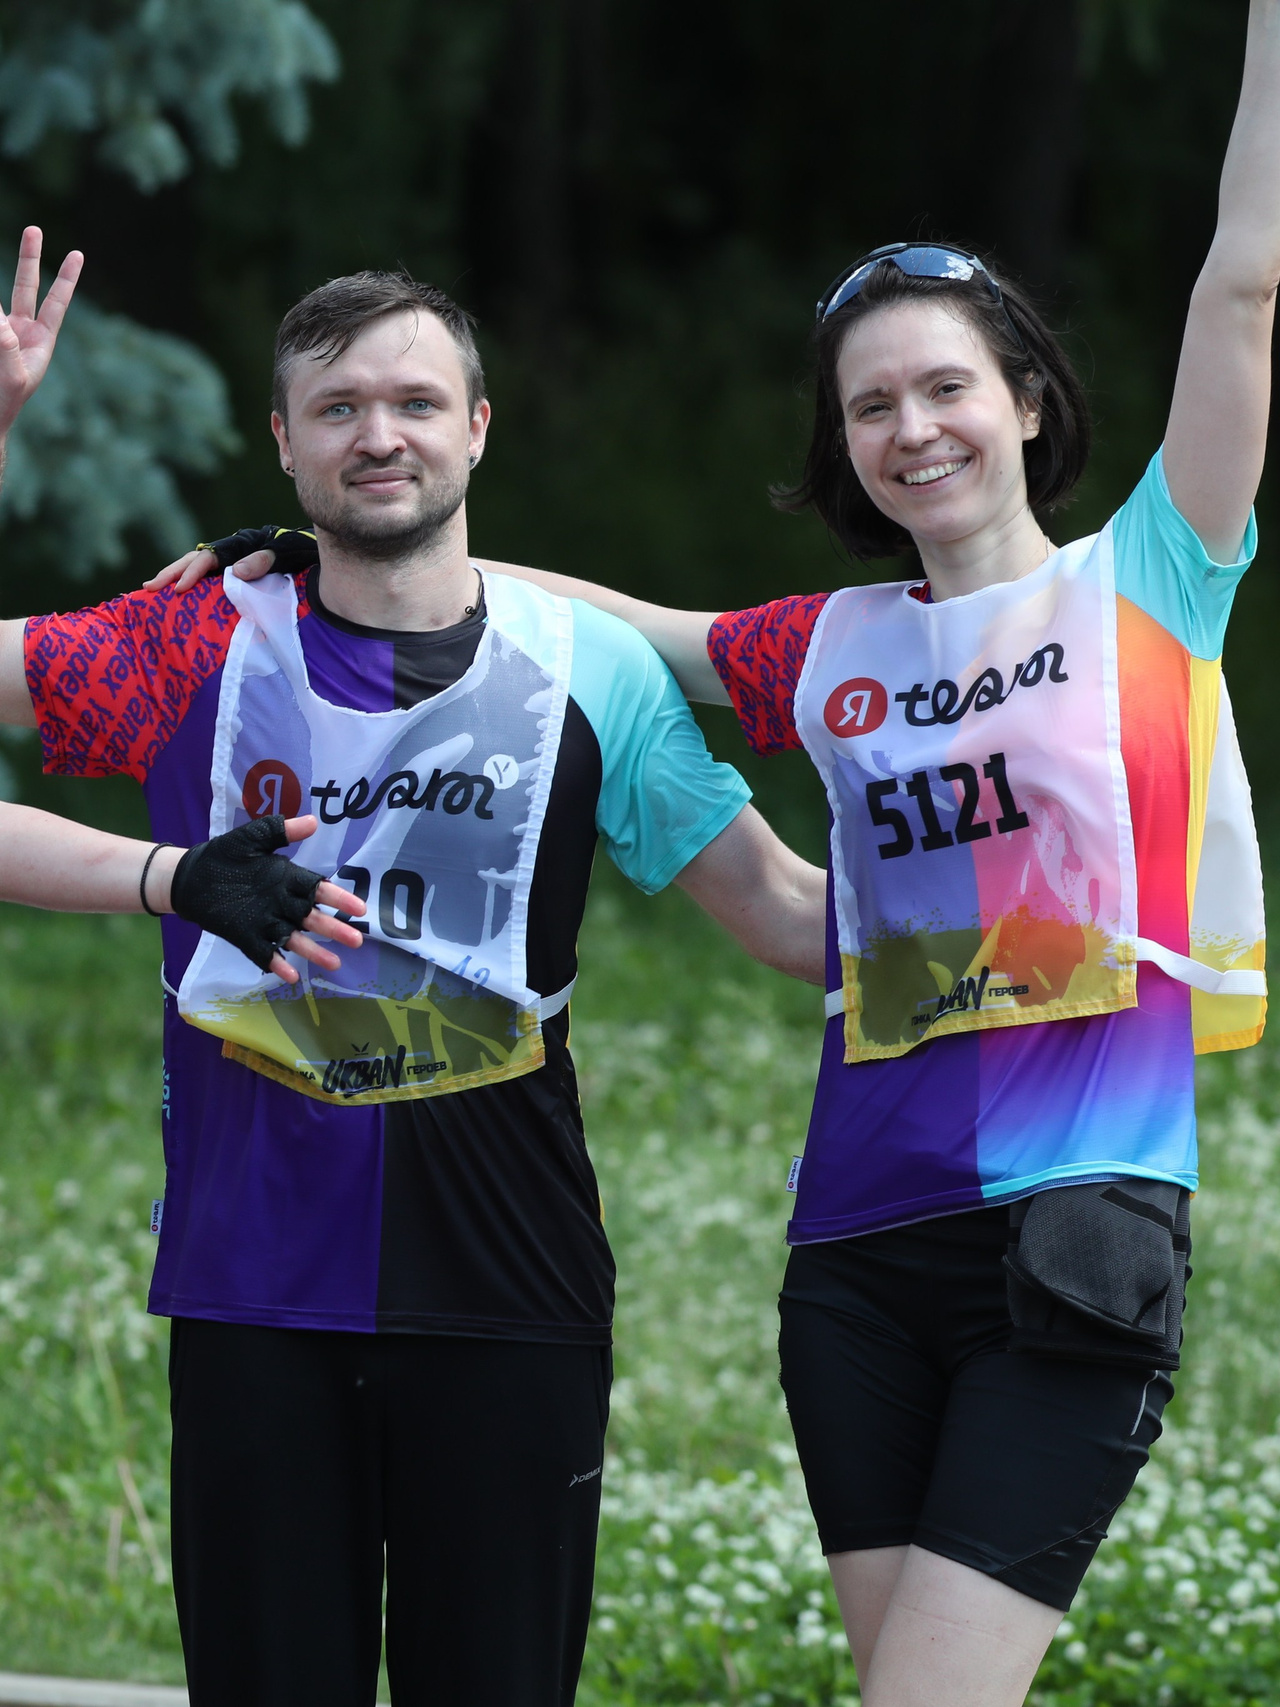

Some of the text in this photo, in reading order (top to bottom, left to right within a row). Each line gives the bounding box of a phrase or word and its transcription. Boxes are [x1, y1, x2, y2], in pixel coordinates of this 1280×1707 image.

[141, 587, 177, 685] andex
[169, 576, 224, 656] andex
[311, 768, 494, 825] team
[866, 752, 1030, 861] 5121
[333, 864, 425, 941] 20
[988, 985, 1030, 998] ГЕРОЕВ
[322, 1044, 407, 1096] URBAN
[407, 1061, 448, 1076] ГЕРОЕВ
